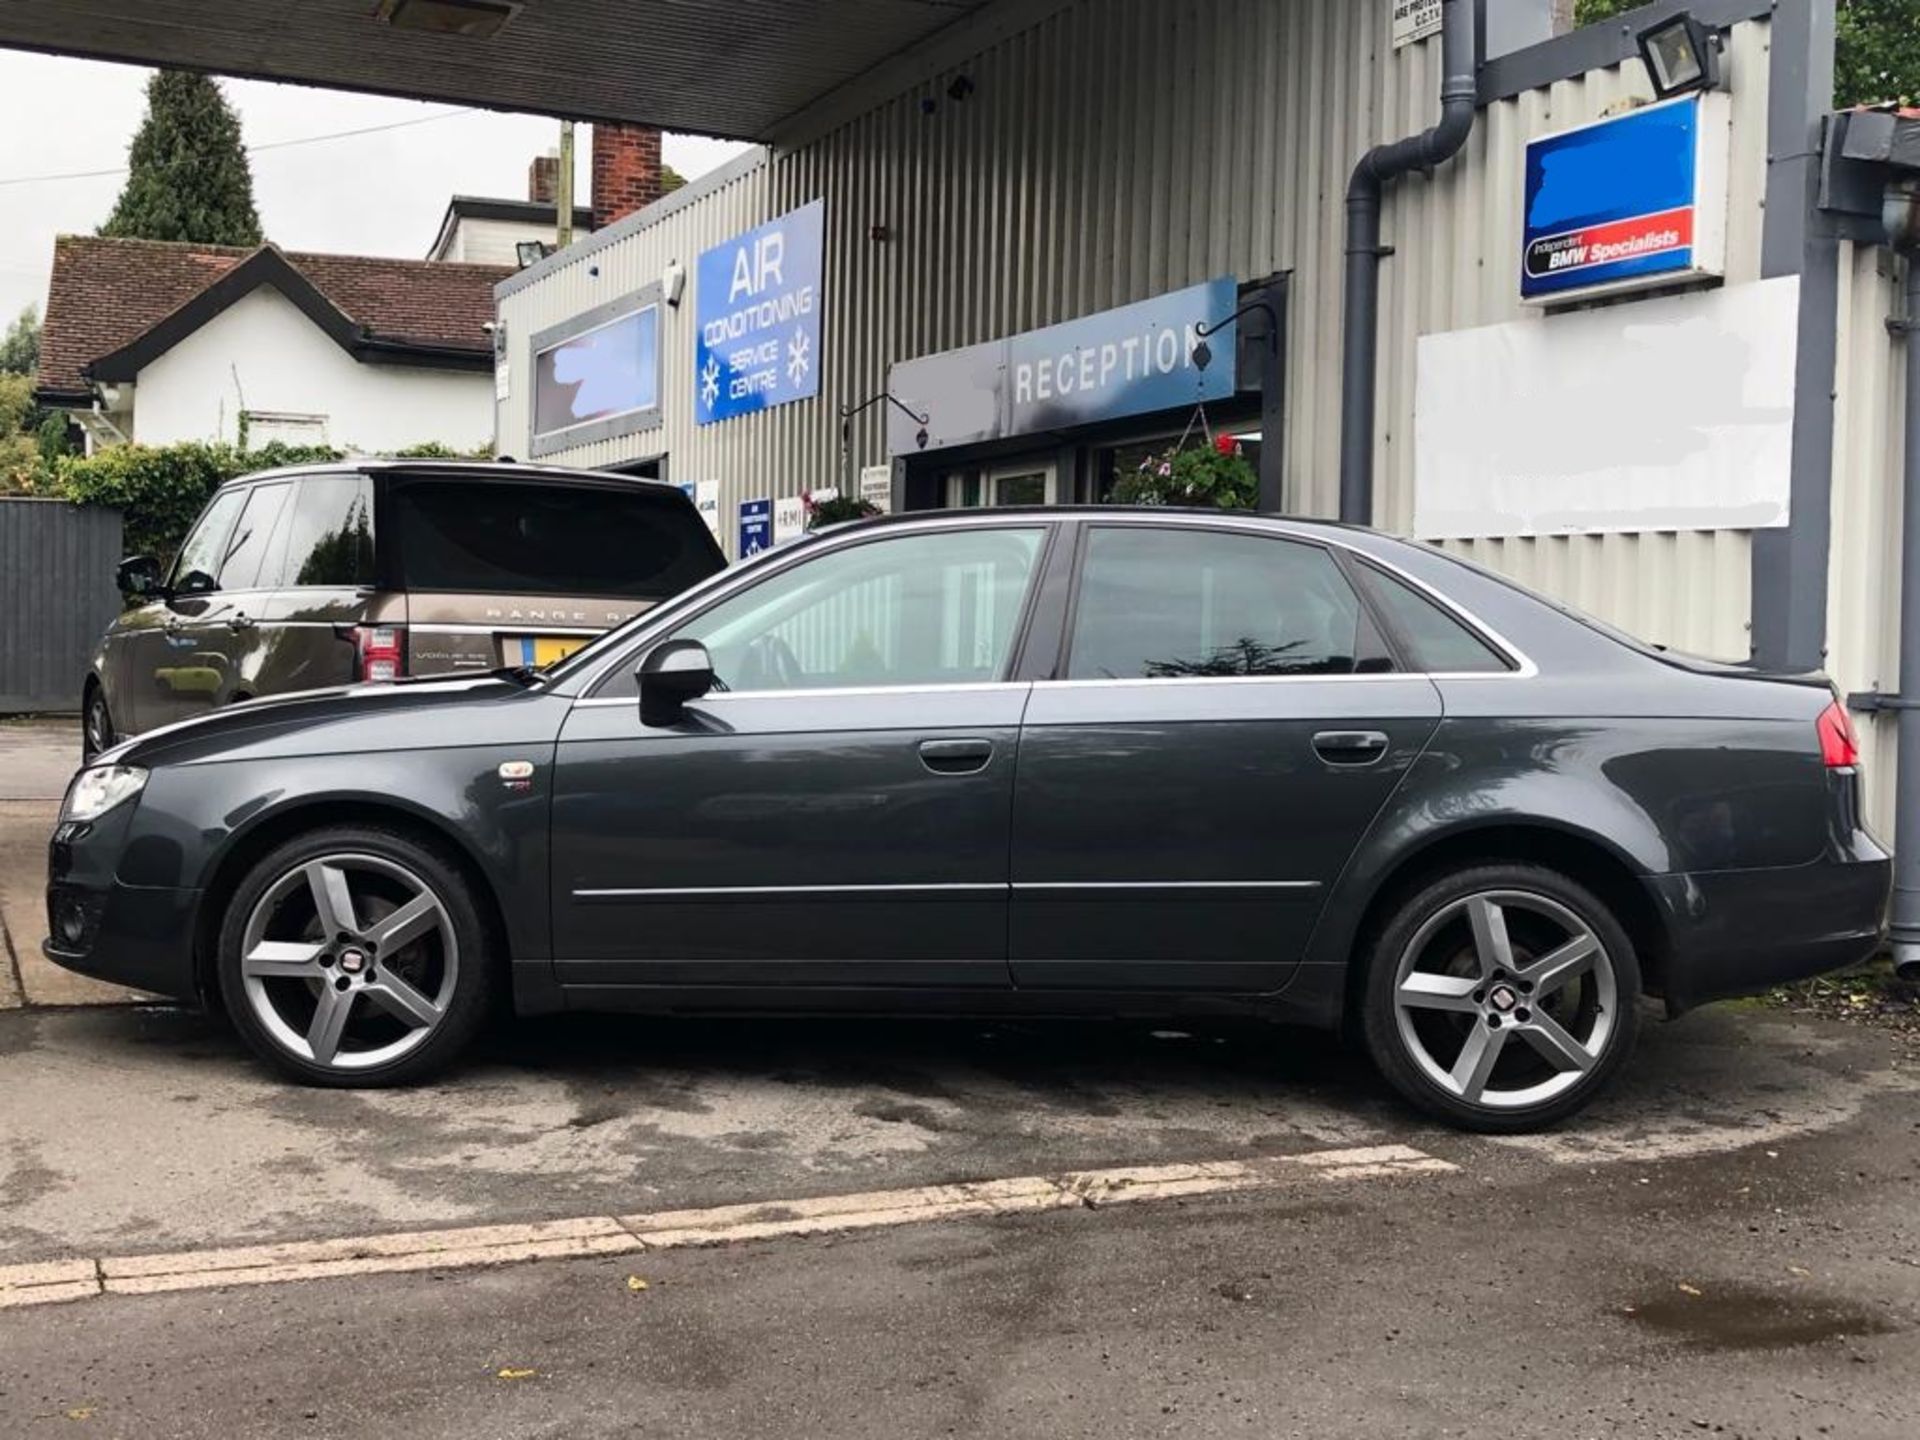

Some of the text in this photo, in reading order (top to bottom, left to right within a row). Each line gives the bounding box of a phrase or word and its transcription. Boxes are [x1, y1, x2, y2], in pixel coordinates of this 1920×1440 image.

[729, 232, 783, 303] AIR
[1549, 230, 1680, 269] BMW Specialists
[704, 286, 812, 348] CONDITIONING
[729, 339, 778, 373] SERVICE
[729, 368, 777, 399] CENTRE
[486, 609, 585, 621] RANGE
